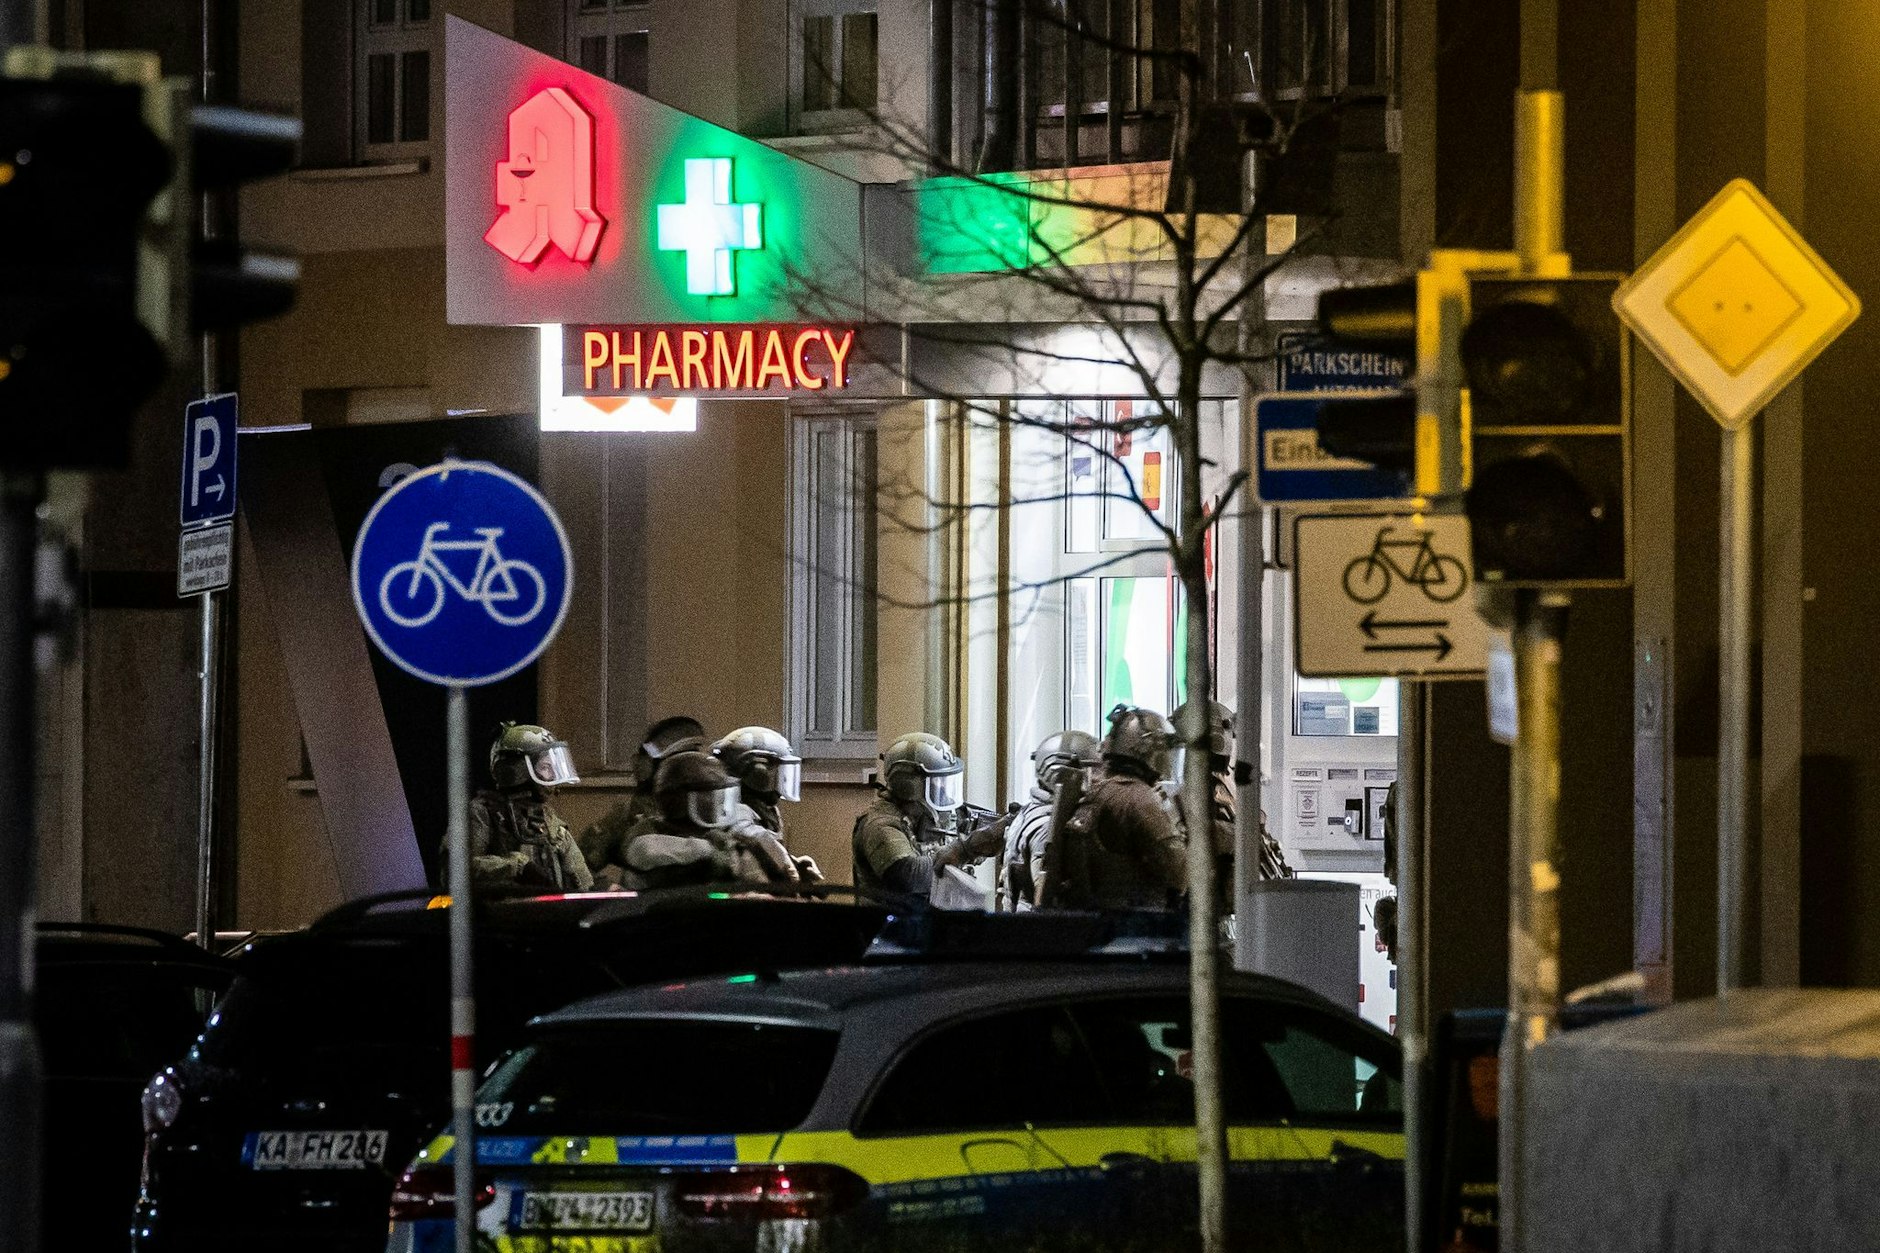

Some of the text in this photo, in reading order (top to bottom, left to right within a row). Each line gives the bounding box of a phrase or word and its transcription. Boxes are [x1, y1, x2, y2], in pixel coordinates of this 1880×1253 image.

[583, 328, 854, 391] PHARMACY
[191, 415, 221, 507] P
[258, 1133, 287, 1160] KA
